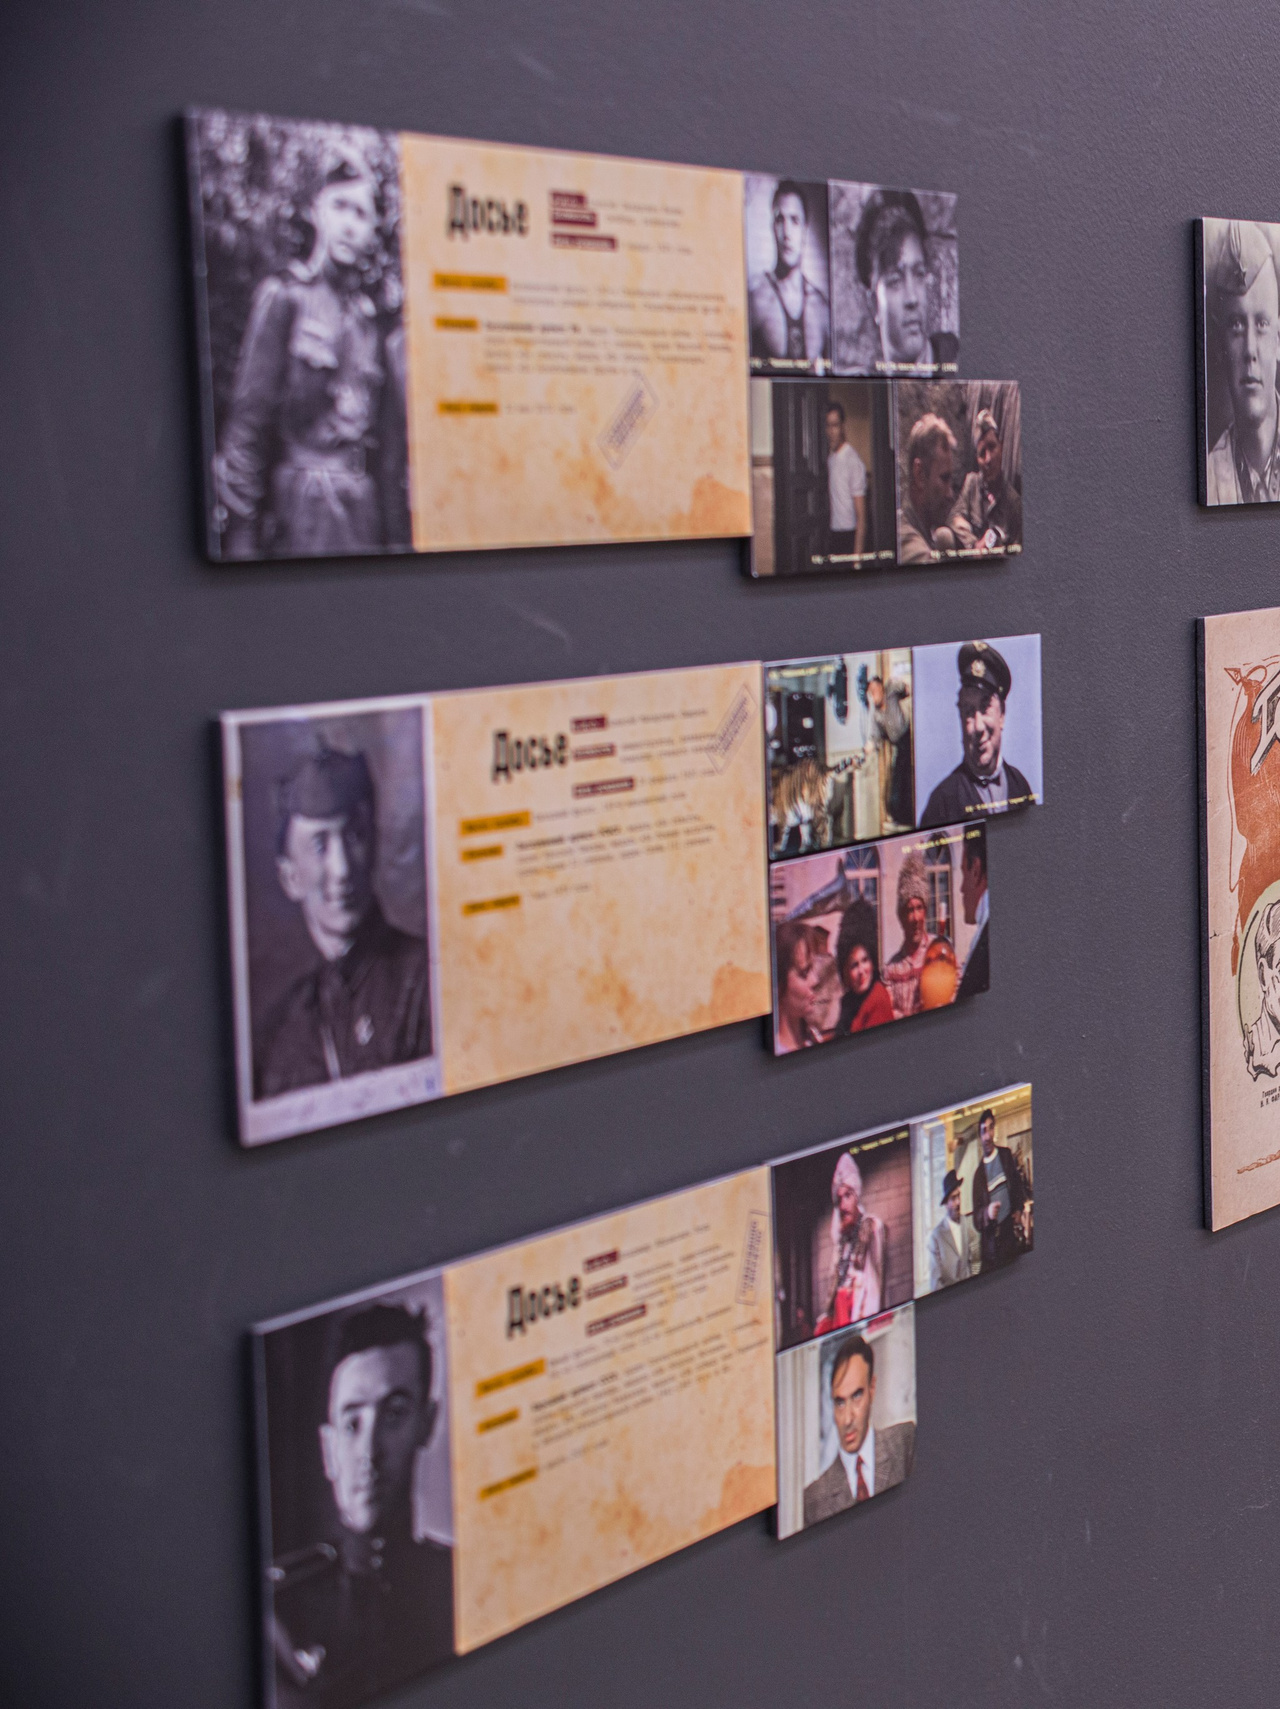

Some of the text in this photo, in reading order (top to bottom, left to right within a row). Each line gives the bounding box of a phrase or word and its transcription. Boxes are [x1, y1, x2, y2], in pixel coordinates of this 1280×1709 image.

[446, 184, 529, 240] Досье
[493, 730, 569, 784] Досье
[507, 1276, 583, 1340] Досье
